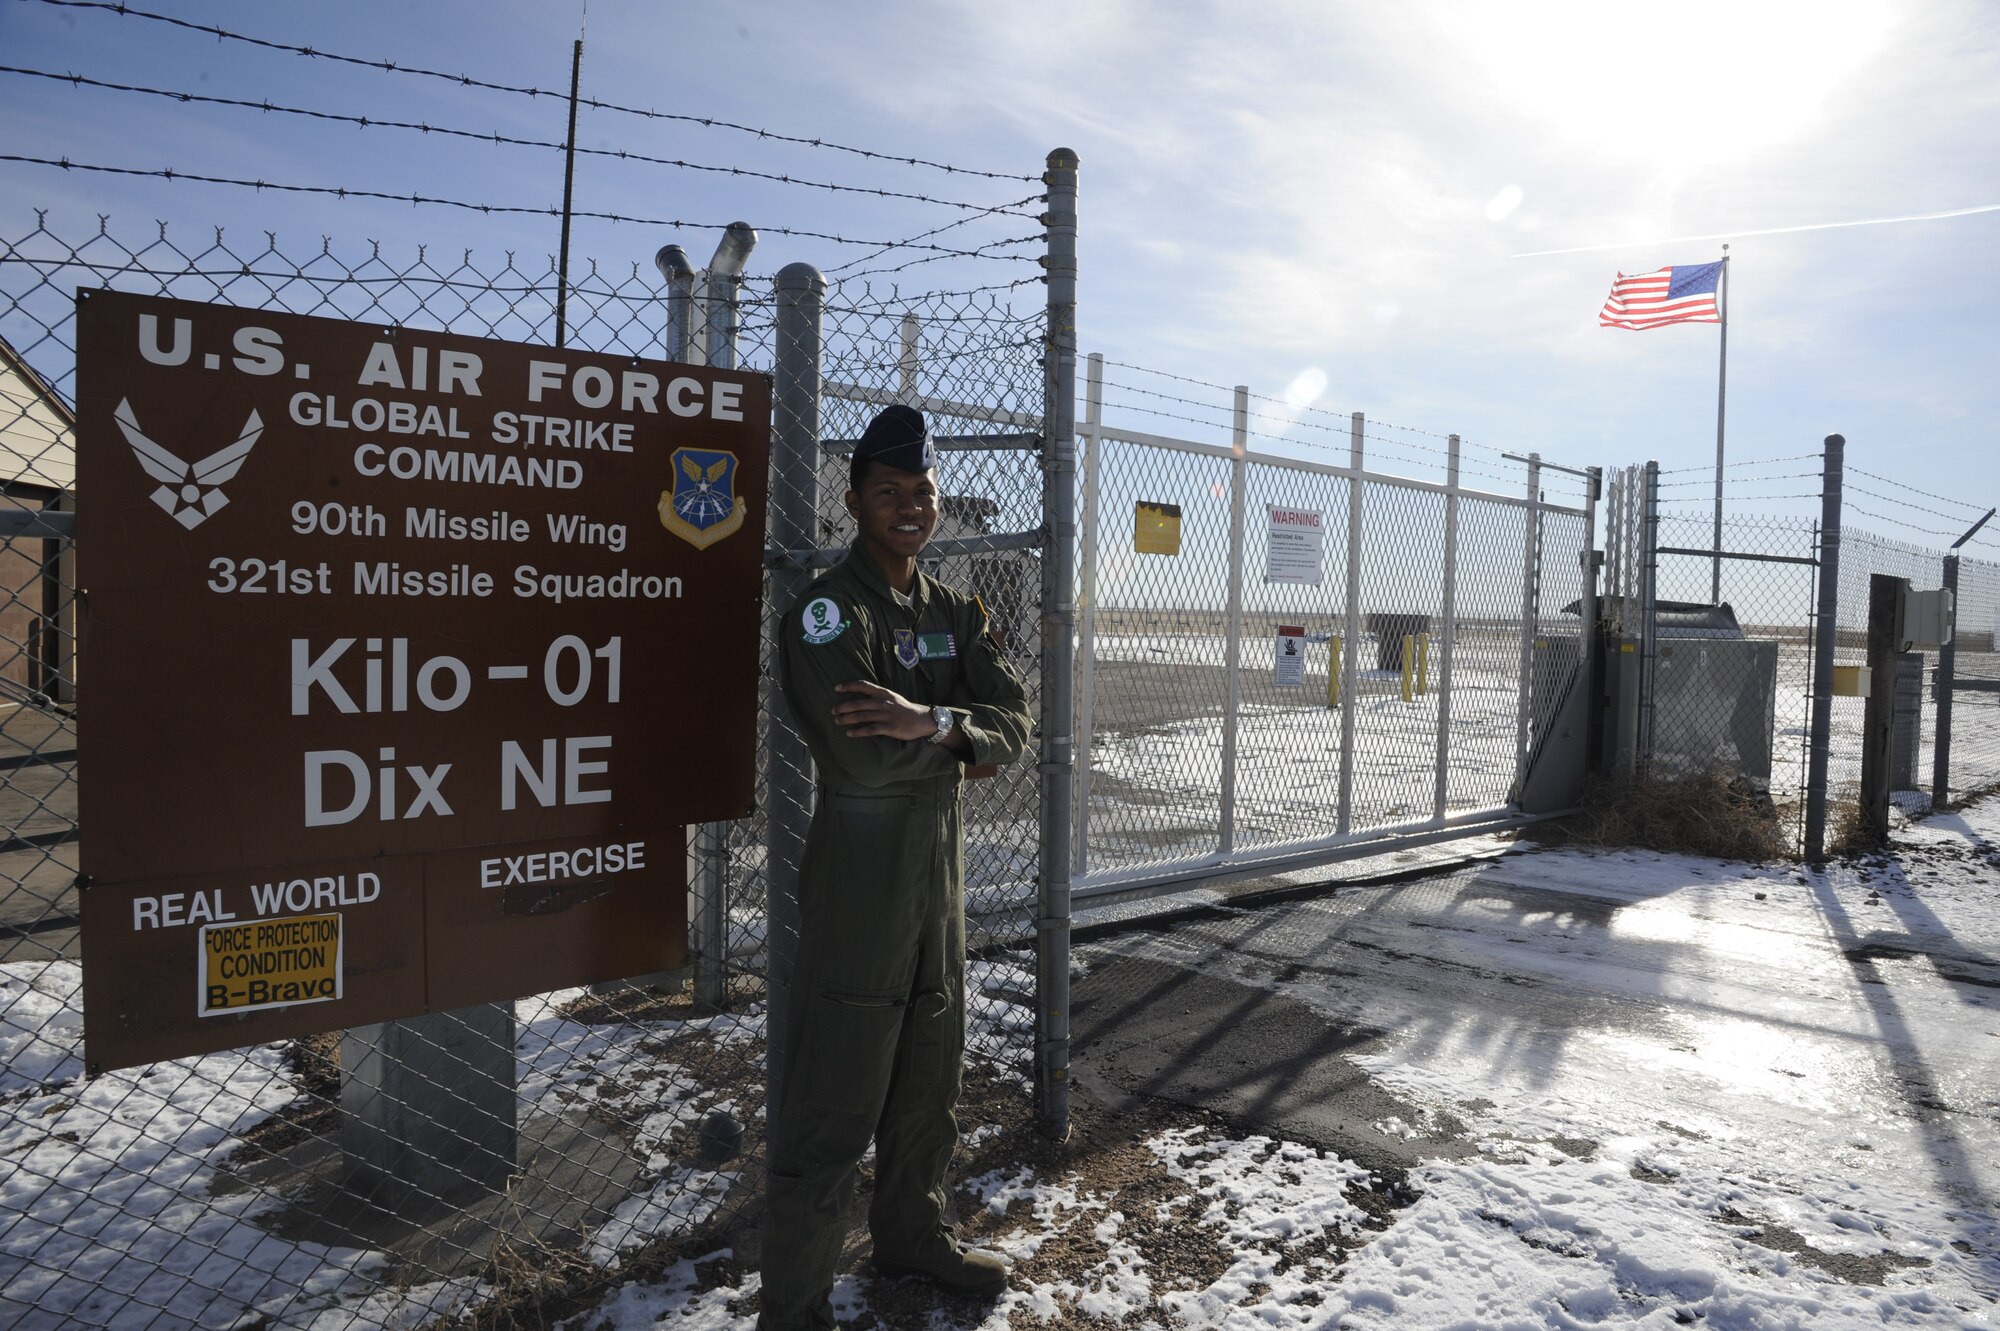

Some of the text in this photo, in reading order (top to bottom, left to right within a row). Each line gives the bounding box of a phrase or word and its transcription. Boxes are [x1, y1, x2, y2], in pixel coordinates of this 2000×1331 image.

[138, 313, 744, 422] U.S. AIR FORCE
[288, 391, 635, 453] GLOBAL STRIKE
[353, 443, 583, 490] COMMAND
[291, 500, 386, 537] 90th
[405, 507, 530, 542] Missile
[546, 513, 627, 553] Wing
[1271, 510, 1320, 528] WARNING
[1271, 532, 1304, 541] Restricted Area
[207, 557, 683, 604] 321st Missile Squadron
[304, 735, 612, 828] Dix NE
[480, 841, 645, 889] EXERCISE
[133, 872, 381, 931] REAL WORLD
[206, 919, 339, 953] FORCE PROTECTION
[220, 946, 325, 979] CONDITION
[207, 977, 336, 1007] B-Bravo
